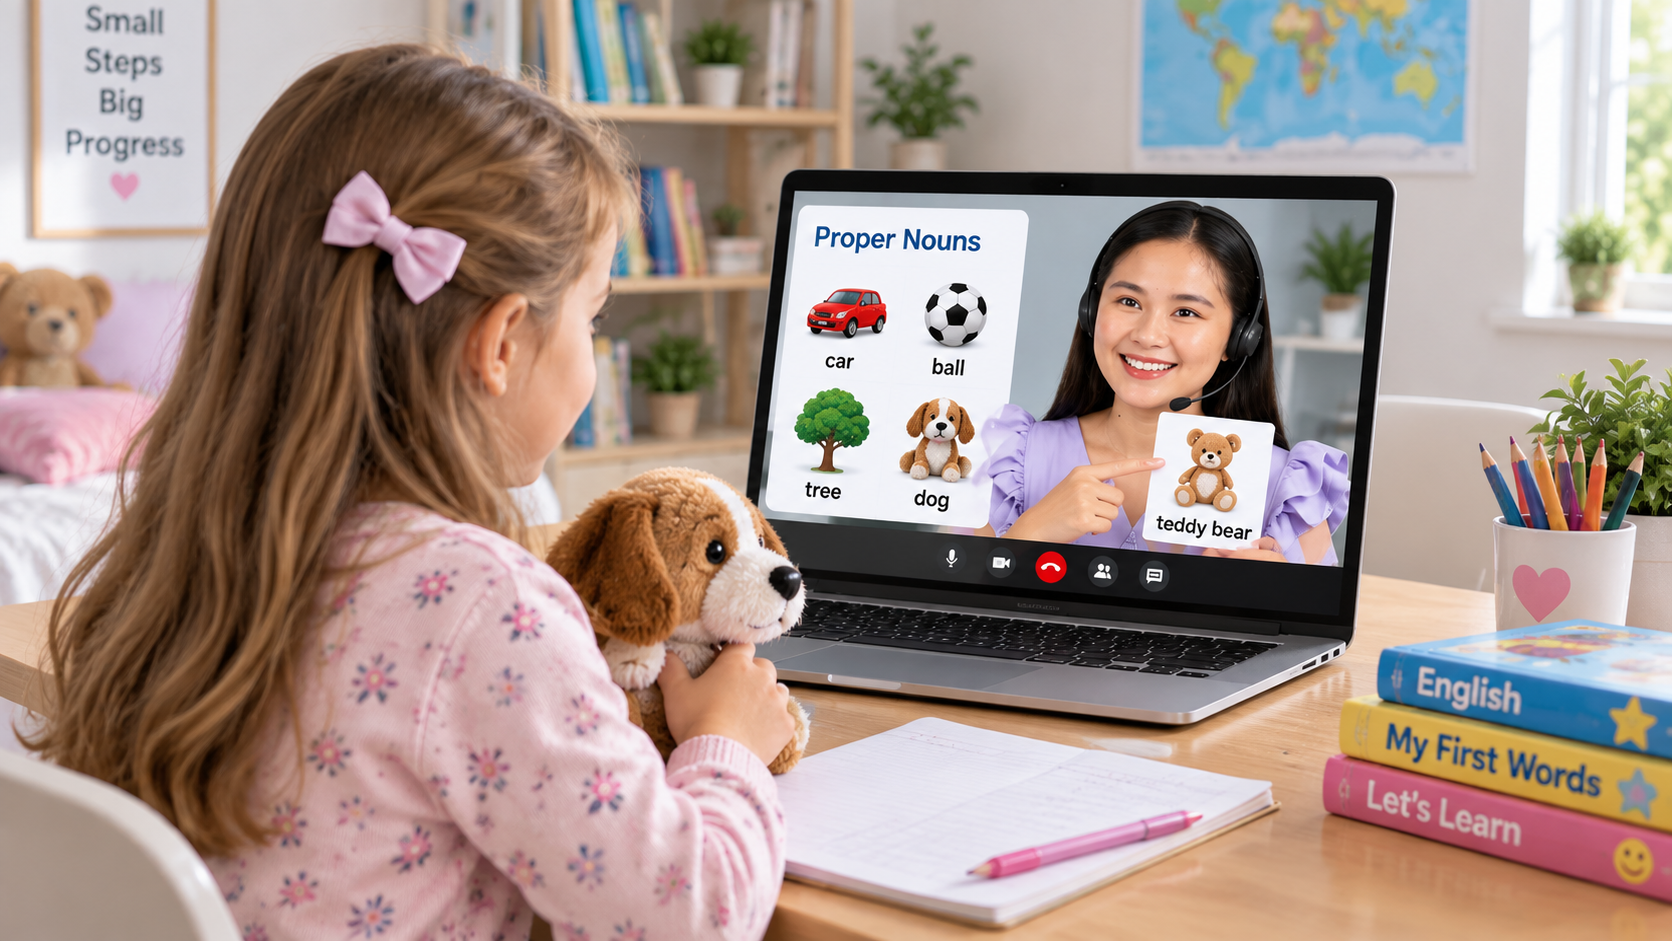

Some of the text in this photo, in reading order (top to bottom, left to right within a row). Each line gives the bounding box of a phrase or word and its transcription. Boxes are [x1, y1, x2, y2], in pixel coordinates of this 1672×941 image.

[85, 4, 164, 35] Small
[85, 47, 162, 81] Steps
[100, 88, 143, 121] Big
[66, 129, 184, 162] Progress
[814, 226, 981, 253] Proper Nouns
[825, 355, 854, 369] car
[932, 358, 965, 376] ball
[805, 482, 842, 499] tree
[914, 490, 950, 512] dog
[1156, 515, 1252, 540] teddy bear
[1417, 666, 1522, 715] English
[1386, 723, 1601, 797] My First Words
[1367, 779, 1522, 846] Let's Learn
